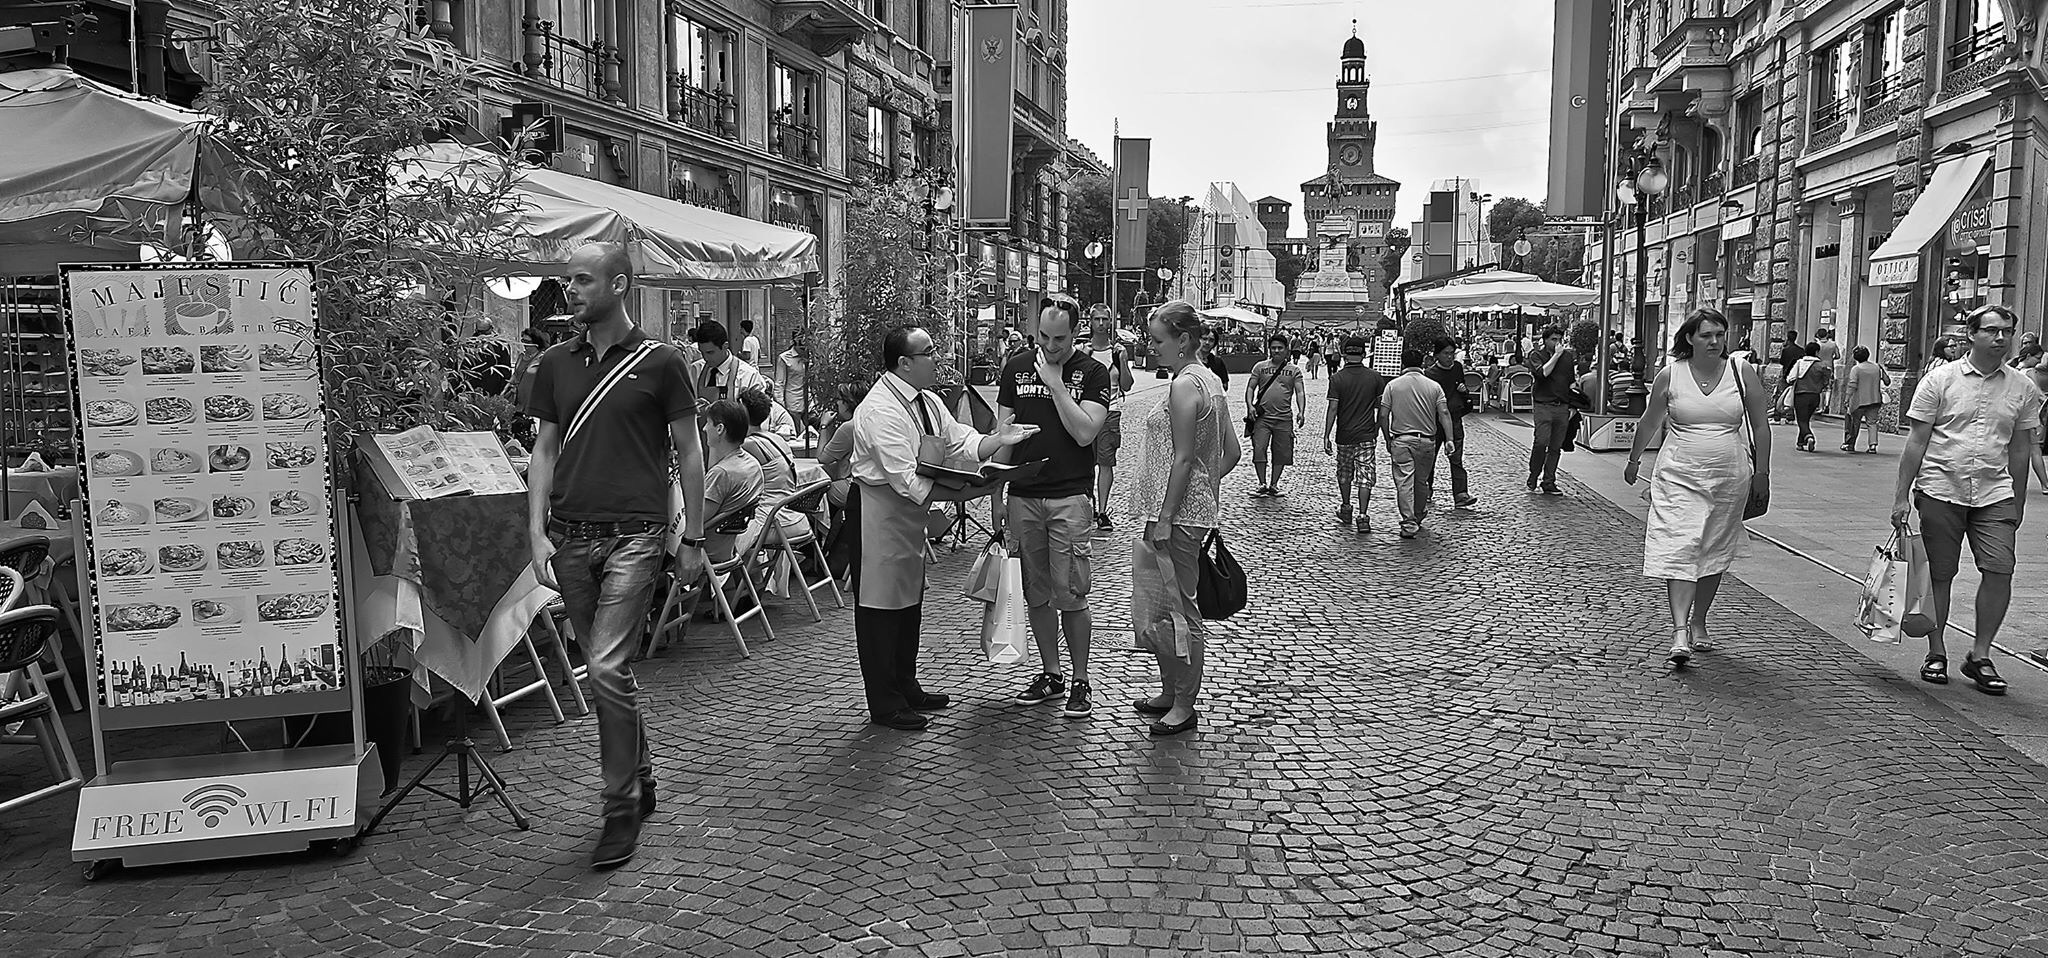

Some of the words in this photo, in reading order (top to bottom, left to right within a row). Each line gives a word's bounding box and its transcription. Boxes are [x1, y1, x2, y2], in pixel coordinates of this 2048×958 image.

[1877, 260, 1909, 275] OTTICA
[91, 276, 297, 309] MAJESTIC
[95, 323, 151, 337] CAFÉ
[89, 809, 184, 841] FREE
[242, 796, 339, 828] WI-FI
